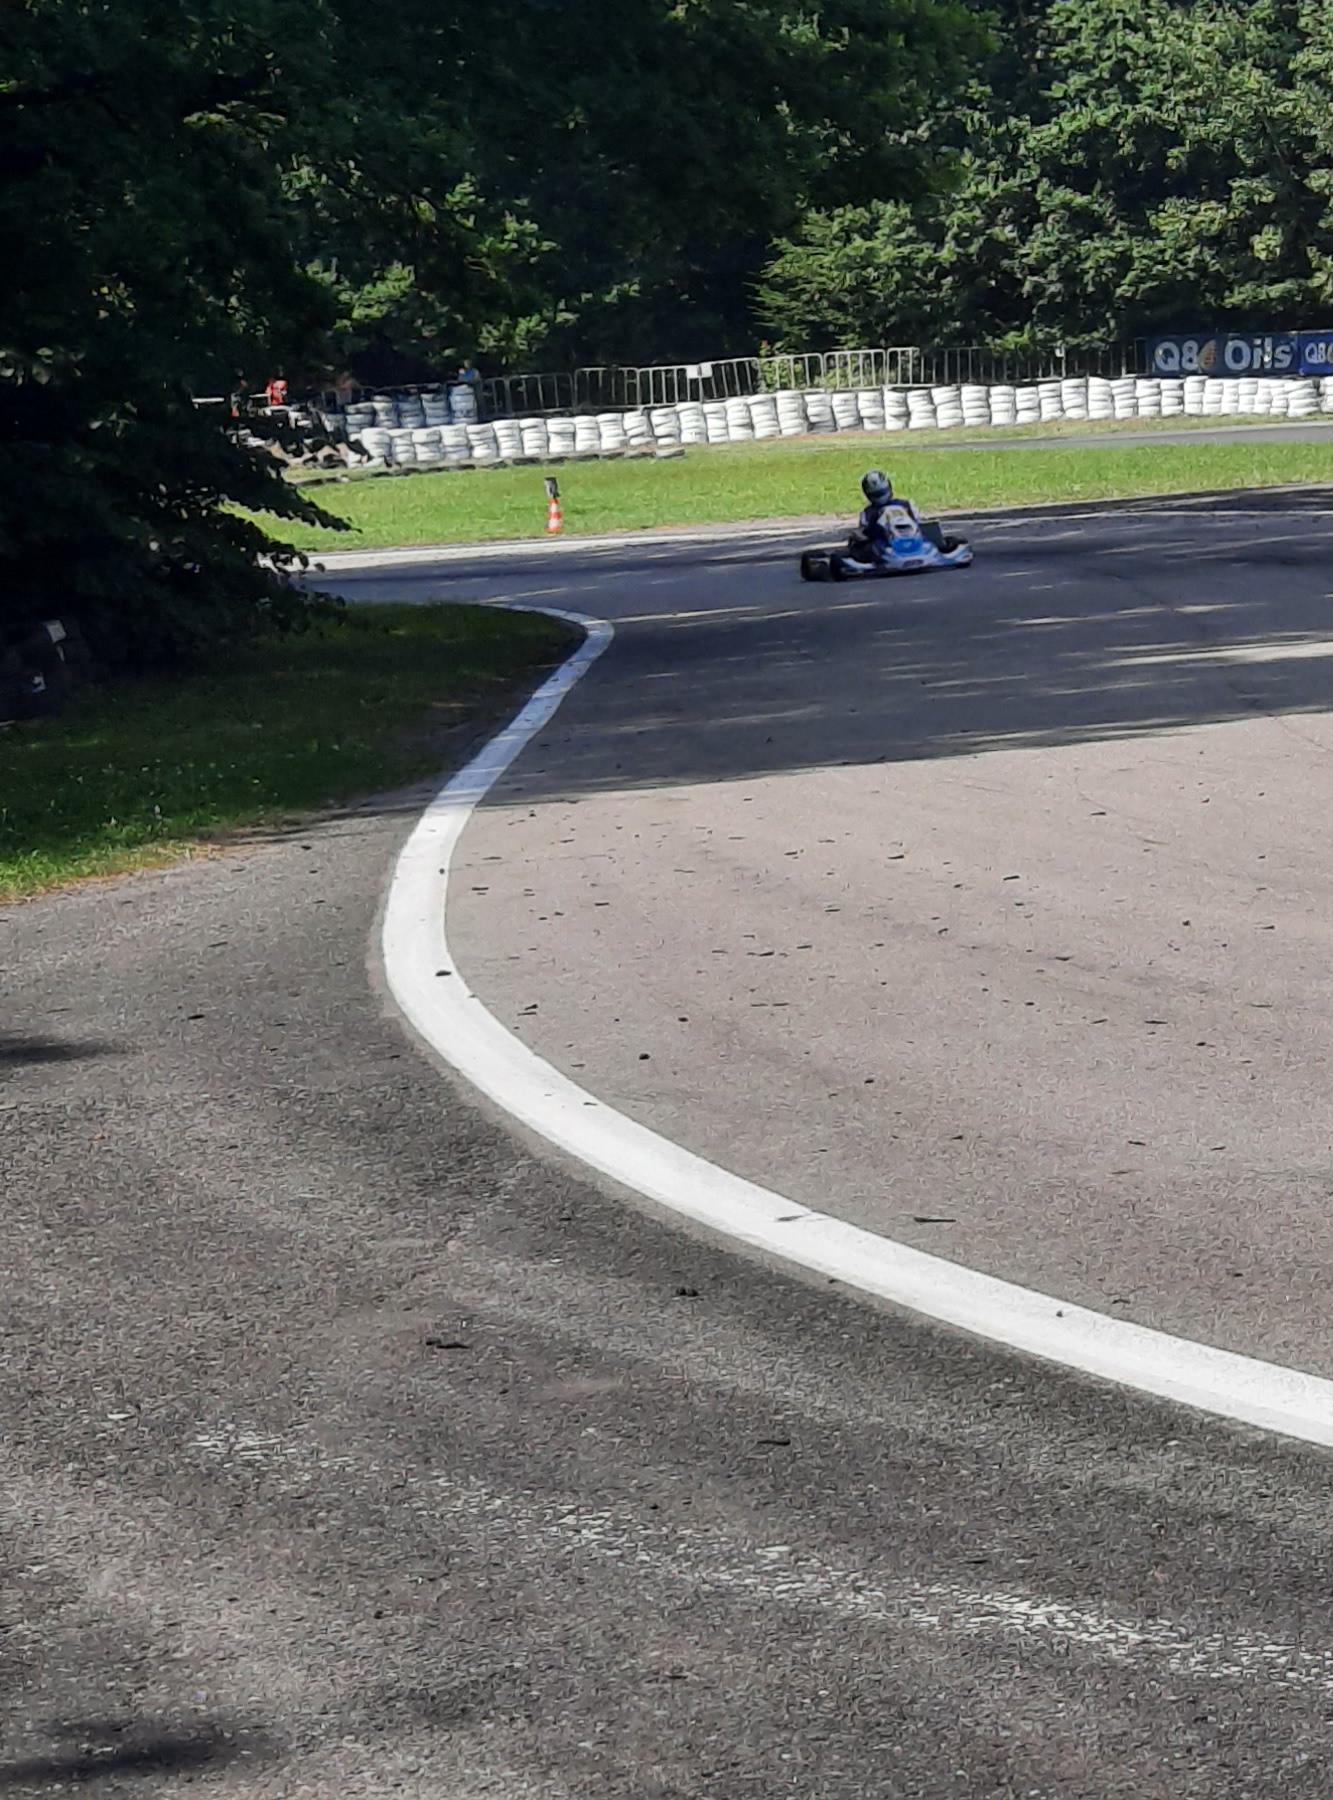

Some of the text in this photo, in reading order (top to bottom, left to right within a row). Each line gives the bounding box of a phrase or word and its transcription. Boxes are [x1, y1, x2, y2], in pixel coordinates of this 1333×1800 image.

[1154, 337, 1293, 371] Q8 Oils
[1304, 342, 1326, 364] Q8
